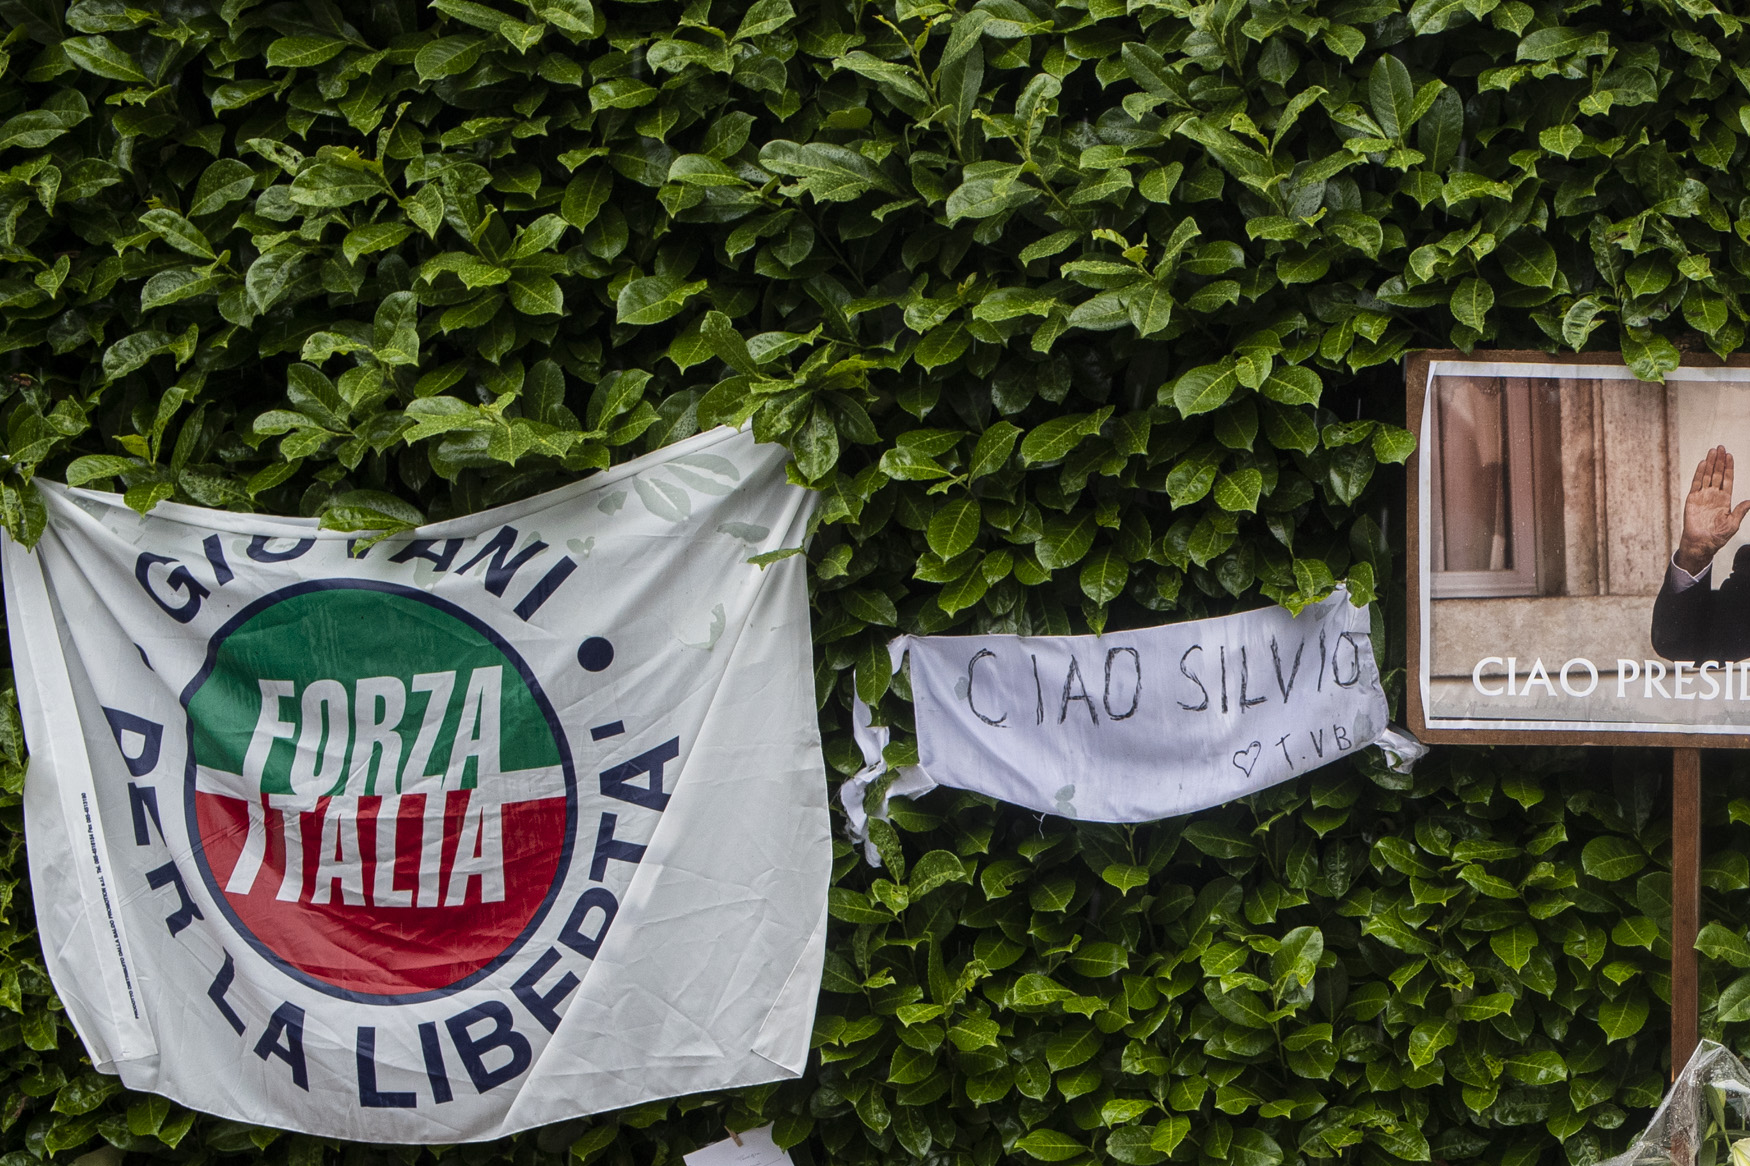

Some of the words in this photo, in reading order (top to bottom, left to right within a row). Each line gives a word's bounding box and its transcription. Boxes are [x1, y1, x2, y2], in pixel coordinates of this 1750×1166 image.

[245, 666, 504, 797] FORZA
[967, 645, 1143, 729] CIAO
[1178, 630, 1362, 715] SILVIO
[1471, 656, 1600, 699] CIAO
[226, 788, 506, 907] ITALIA
[207, 953, 311, 1091] LA
